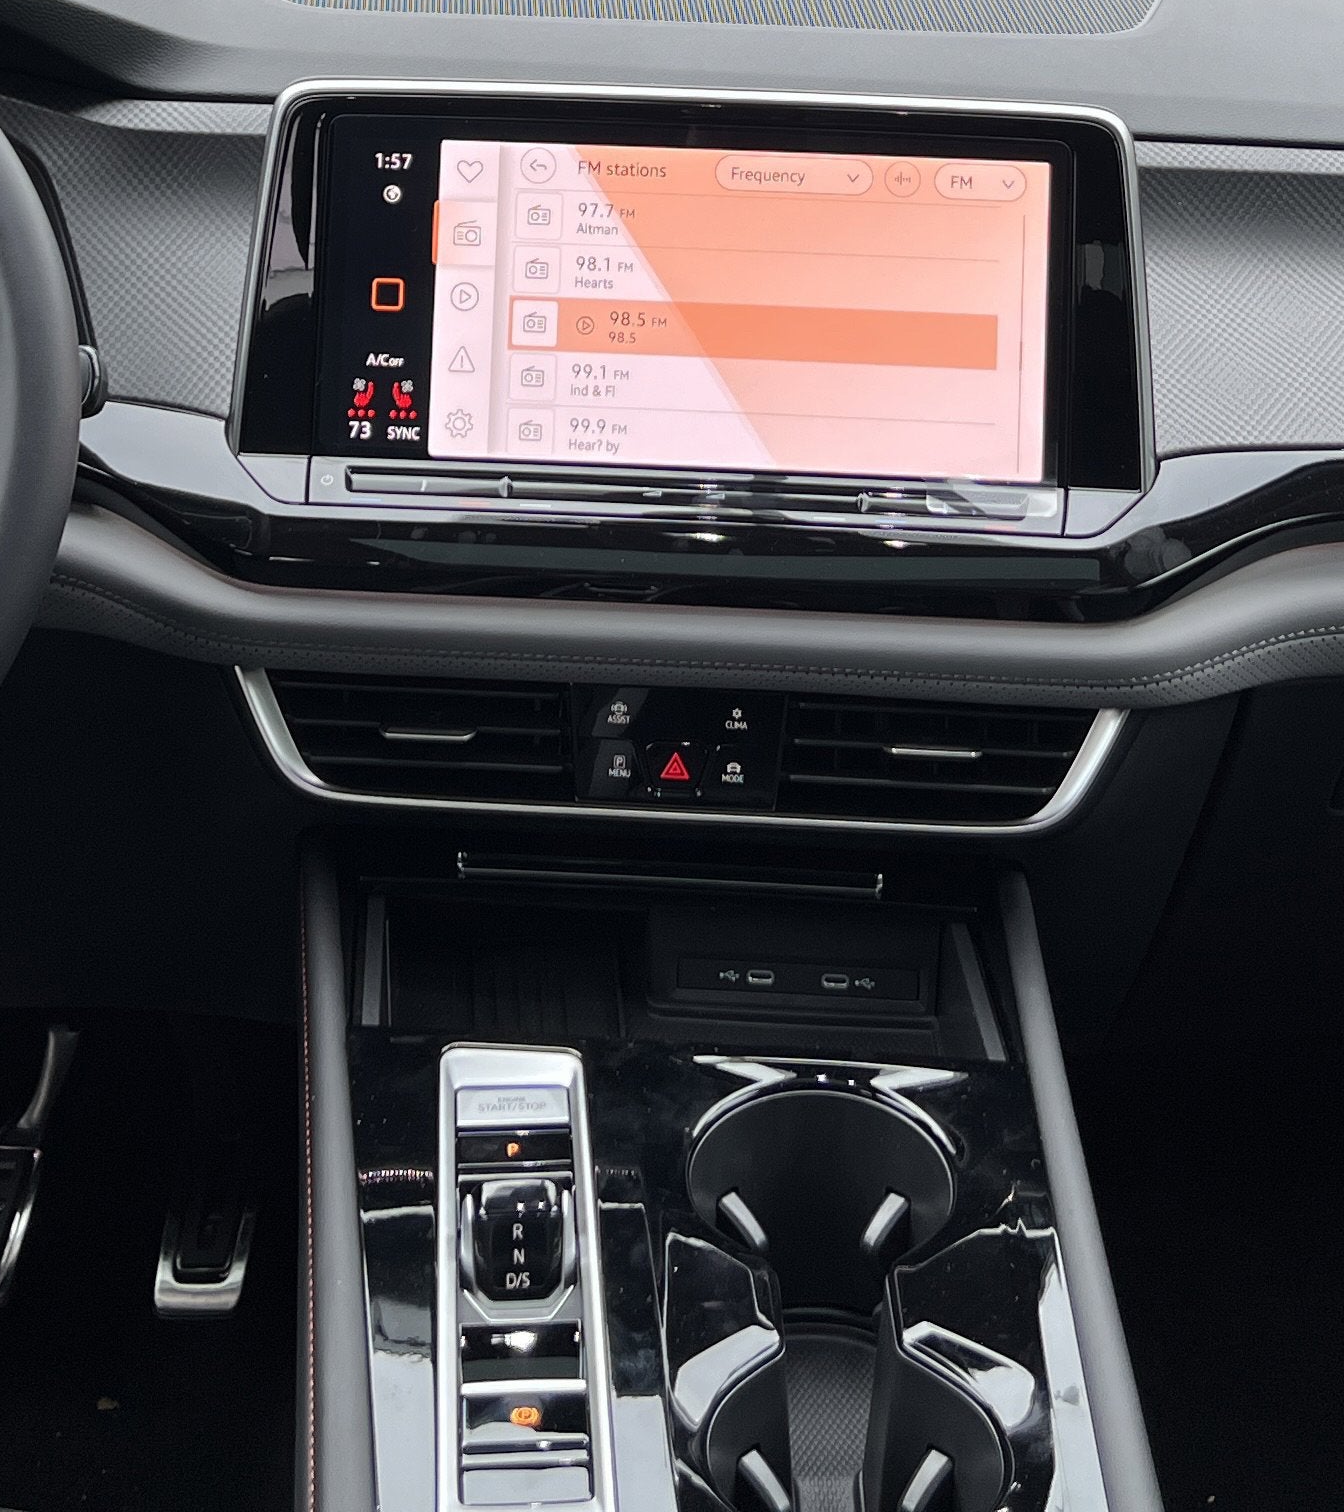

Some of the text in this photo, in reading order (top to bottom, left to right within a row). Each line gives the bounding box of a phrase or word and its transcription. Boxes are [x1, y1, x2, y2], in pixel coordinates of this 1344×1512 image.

[374, 152, 413, 171] 1:57
[578, 161, 667, 179] FM stations
[730, 166, 806, 187] Frequency
[950, 175, 974, 191] FM
[577, 202, 636, 220] 97.7 FM
[575, 222, 620, 237] Altman
[574, 255, 634, 273] 98.1 FM
[573, 275, 614, 290] Hearts
[608, 310, 668, 328] 98.5 FM
[607, 330, 637, 345] 98.5
[571, 363, 630, 381] 99.1 FM
[592, 384, 602, 397] &
[348, 420, 372, 440] 73
[386, 425, 421, 442] SYNC
[568, 417, 628, 436] 99.9 FM
[567, 438, 621, 455] Hear? by
[606, 714, 632, 725] ASSIST
[724, 719, 748, 731] CLIMA
[608, 767, 632, 778] MENU
[721, 773, 745, 785] MODE
[478, 1101, 546, 1113] START/STOP
[512, 1223, 524, 1241] R
[513, 1247, 525, 1265] N
[505, 1271, 531, 1290] D/S
